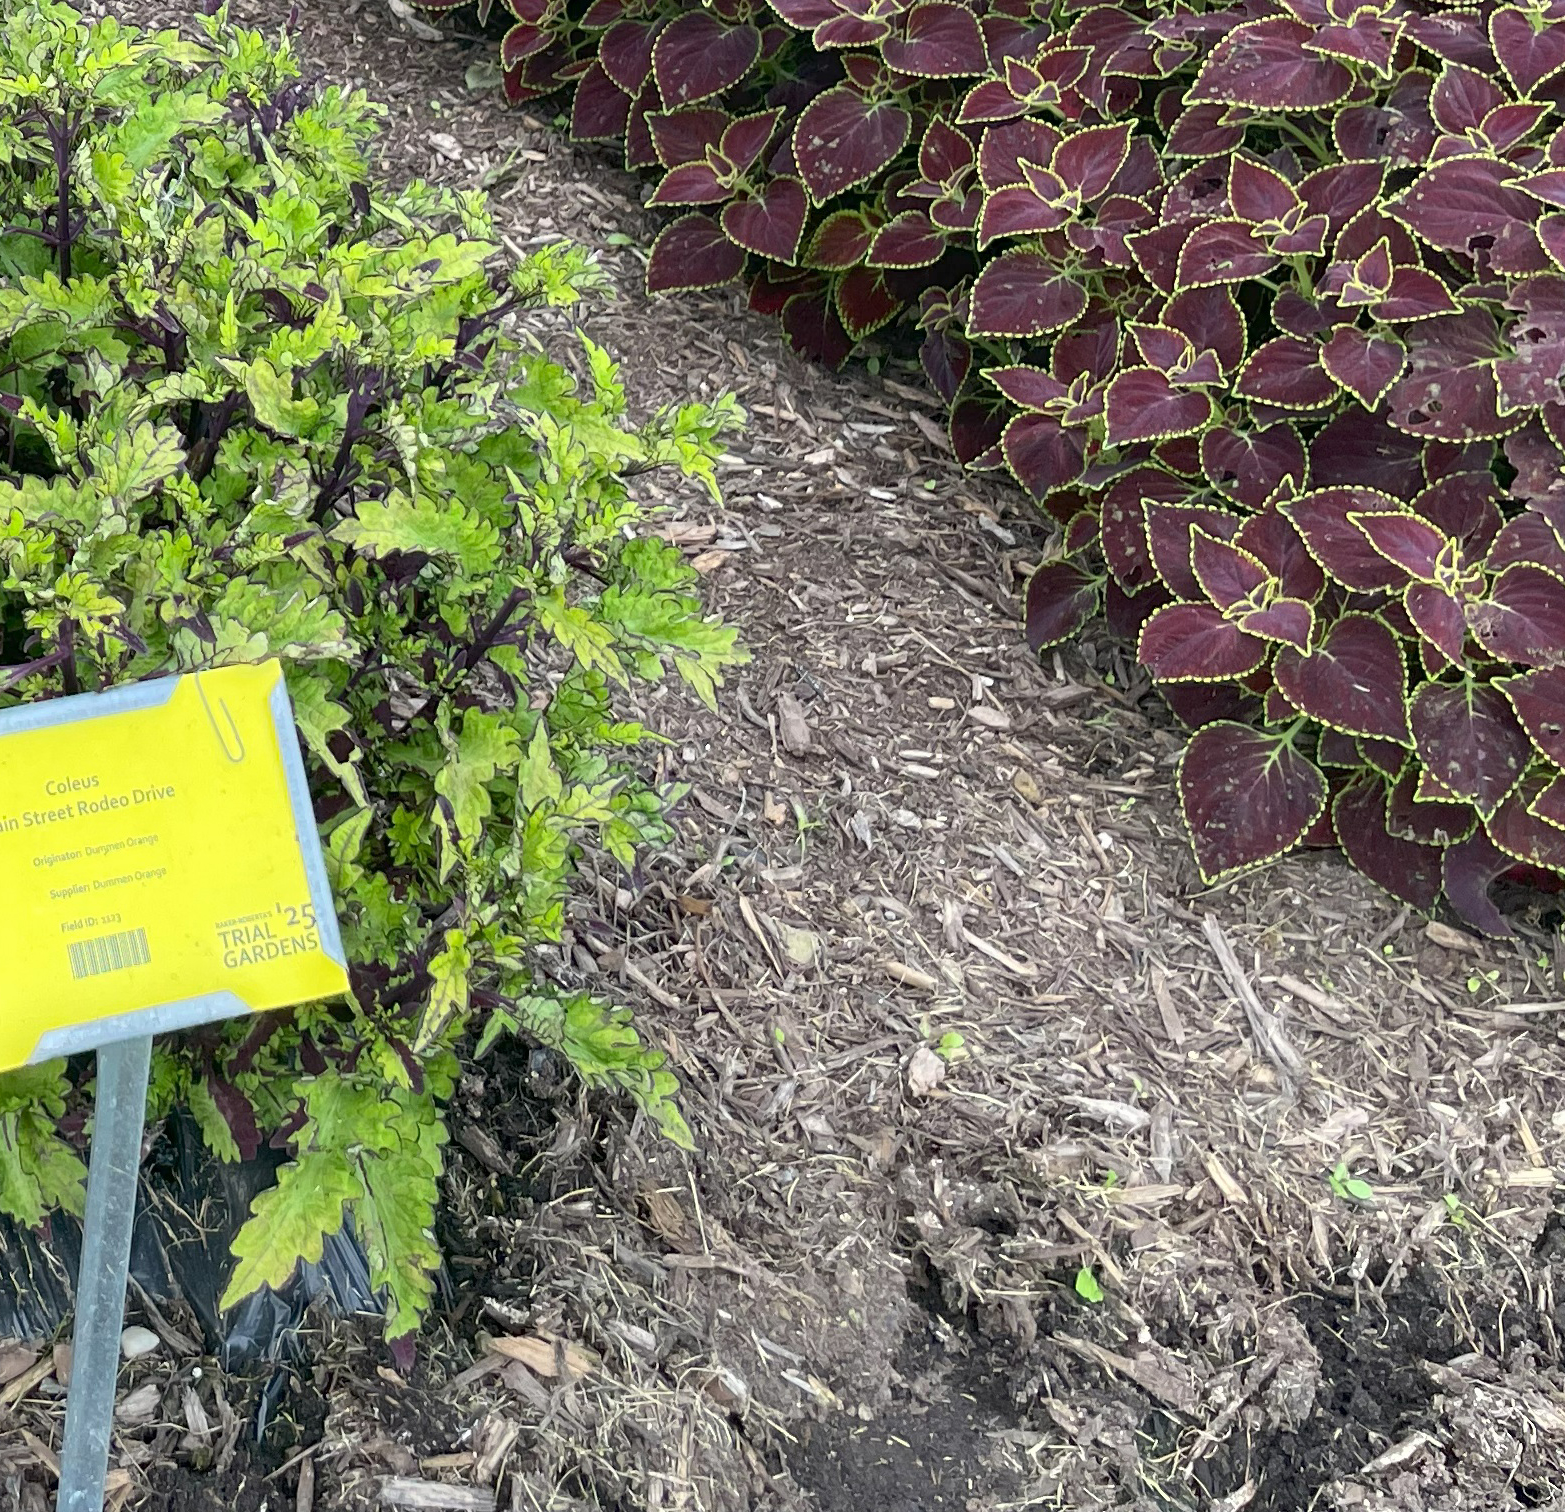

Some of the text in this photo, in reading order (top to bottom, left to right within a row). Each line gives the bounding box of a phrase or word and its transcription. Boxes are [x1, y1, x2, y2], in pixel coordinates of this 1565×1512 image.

[45, 774, 100, 796] Coleus
[22, 803, 75, 828] Street
[77, 793, 130, 816] Rodeo
[132, 783, 176, 805] Drive
[126, 833, 159, 848] Orange
[92, 873, 134, 890] Dummen
[134, 866, 167, 881] Orange
[60, 918, 84, 934] Field
[85, 915, 99, 928] ID:
[217, 921, 278, 949] TRIAL
[223, 931, 318, 969] GARDENS
